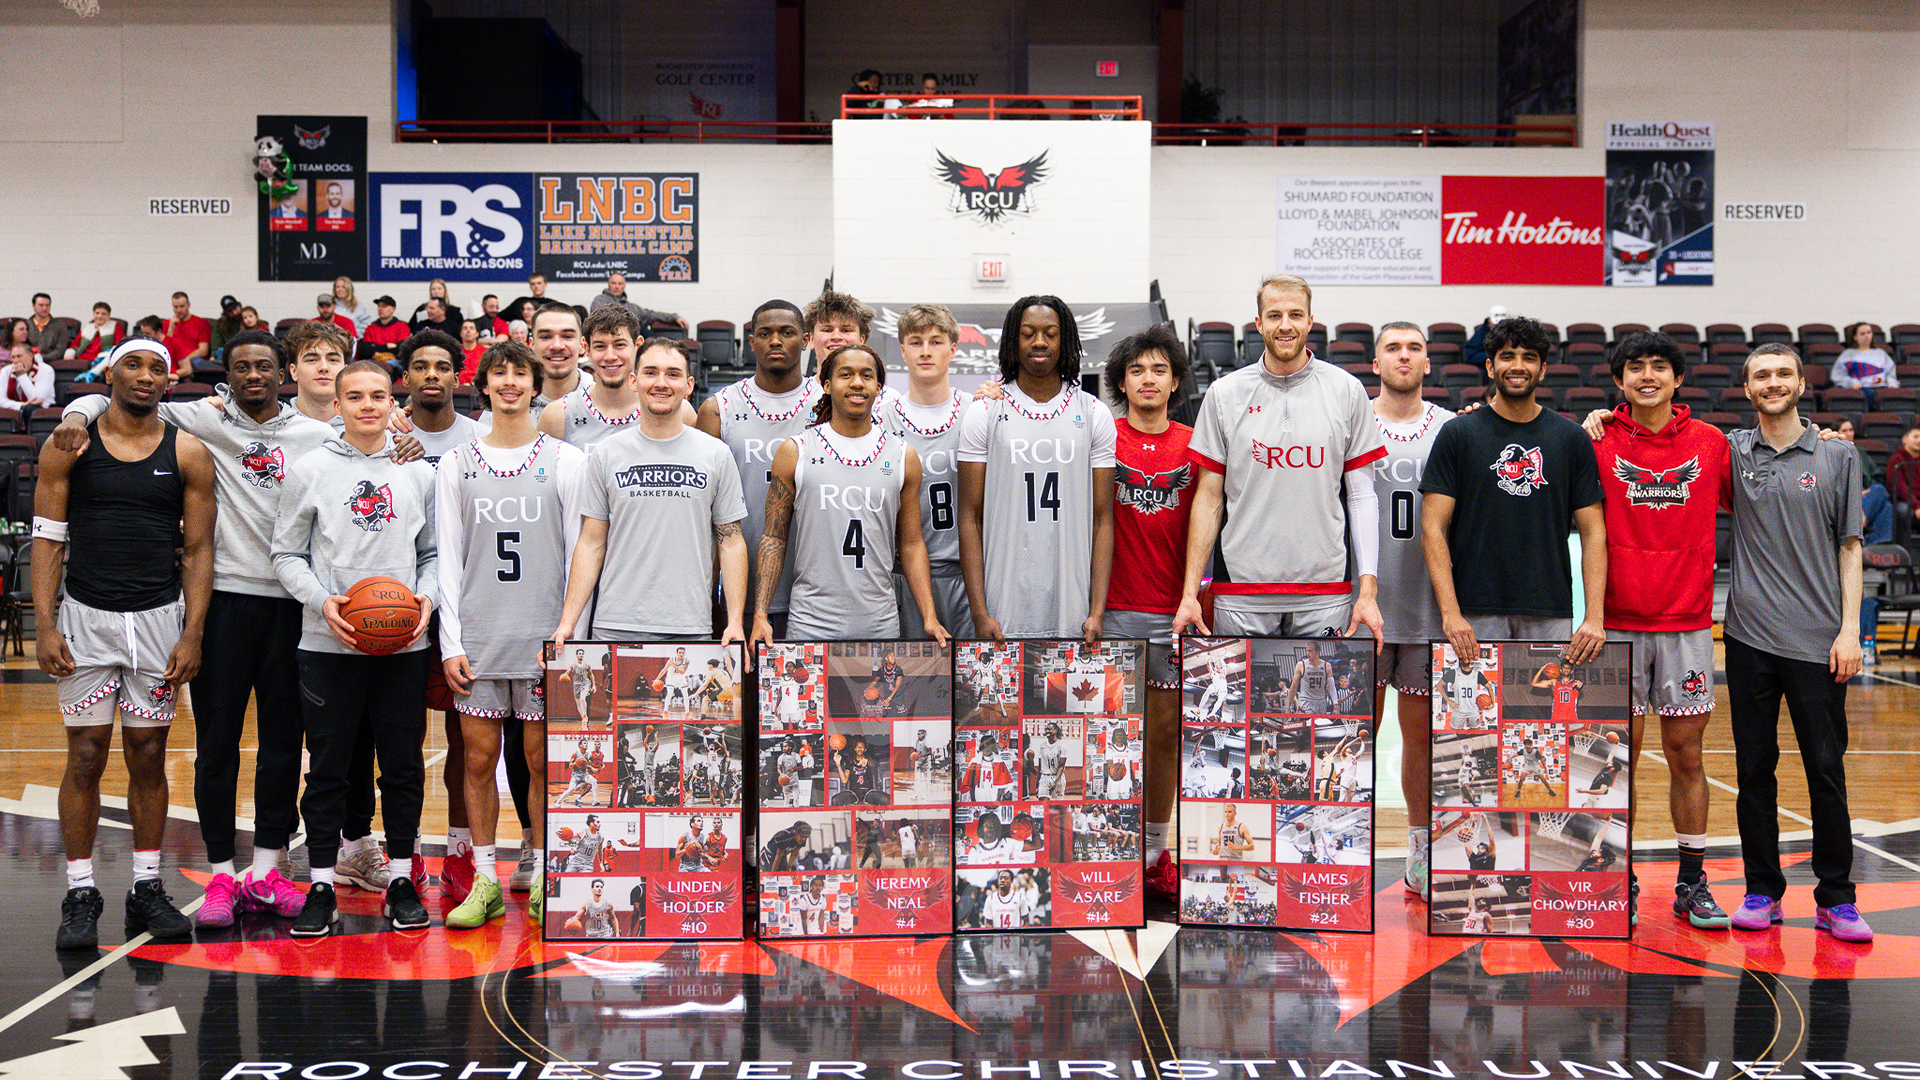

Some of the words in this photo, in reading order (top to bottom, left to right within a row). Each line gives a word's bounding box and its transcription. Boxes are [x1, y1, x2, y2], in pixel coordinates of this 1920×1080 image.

[655, 73, 694, 85] GOLF
[699, 73, 755, 85] CENTER
[1611, 121, 1710, 142] HealthQuest
[299, 164, 323, 172] TEAM
[325, 164, 353, 172] DOCS:
[540, 177, 694, 224] LNBC
[971, 191, 1014, 210] RCU
[1284, 191, 1348, 203] SHUMARD
[1351, 191, 1434, 203] FOUNDATION
[150, 200, 230, 216] RESERVED
[1278, 208, 1319, 221] LLOYD
[1321, 208, 1330, 221] &
[1333, 208, 1373, 221] MABEL
[1379, 208, 1439, 221] JOHNSON
[1725, 205, 1804, 221] RESERVED
[1317, 219, 1400, 231] FOUNDATION
[1443, 211, 1494, 245] Tim
[1496, 210, 1601, 245] Hortons
[540, 225, 586, 240] LAKE
[588, 225, 694, 240] NORCENTRA
[540, 240, 646, 254] BASKETBALL
[648, 240, 693, 254] CAMP
[1311, 237, 1385, 249] ASSOCIATES
[1388, 237, 1405, 249] OF
[300, 242, 327, 260] MD
[1294, 248, 1365, 260] ROCHESTER
[1368, 248, 1424, 260] COLLEGE
[381, 258, 425, 269] FRANK
[982, 261, 1003, 278] EXIT
[659, 270, 692, 281] TEAM
[744, 438, 790, 464] RC
[1009, 437, 1076, 464] RCU
[1267, 445, 1325, 470] RCU
[616, 470, 707, 489] WARRIORS
[630, 490, 691, 499] BASKETBALL
[819, 483, 886, 513] RCU
[1023, 470, 1061, 523] 14
[1133, 489, 1164, 503] RCU
[1634, 489, 1683, 499] WARRIORS
[473, 496, 542, 524] RCU
[928, 480, 955, 531] 8
[1390, 489, 1416, 541] 0
[841, 517, 866, 571] 4
[496, 530, 522, 583] 5
[1872, 553, 1901, 566] RCU
[379, 590, 406, 601] RCU
[362, 615, 414, 630] SPALDING
[1309, 676, 1323, 689] 24
[785, 687, 791, 697] 4
[1461, 687, 1473, 698] 30
[1559, 691, 1570, 703] 10
[1047, 758, 1055, 768] 14
[982, 769, 992, 782] 14
[584, 847, 594, 857] 10
[982, 852, 1005, 862] WARRIORS
[1080, 871, 1115, 883] WILL
[1301, 872, 1348, 885] JAMES
[667, 880, 722, 893] LINDEN
[875, 877, 931, 891] JEREMY
[1567, 881, 1592, 893] VIR
[887, 897, 925, 910] NEAL
[1072, 891, 1123, 903] ASARE
[1299, 892, 1350, 905] FISHER
[663, 901, 725, 913] HOLDER
[1533, 899, 1628, 912] CHOWDHARY
[590, 911, 606, 919] RCU
[809, 912, 816, 922] 4
[999, 914, 1011, 928] 14
[1086, 911, 1111, 923] #14
[1310, 912, 1339, 925] #24
[593, 919, 602, 930] 10
[681, 921, 707, 934] #10
[896, 917, 916, 929] #4
[1465, 919, 1476, 930] 30
[1566, 918, 1594, 930] #30
[221, 1061, 866, 1080] ROCHESTER
[901, 1060, 1456, 1080] CHRISTIAN
